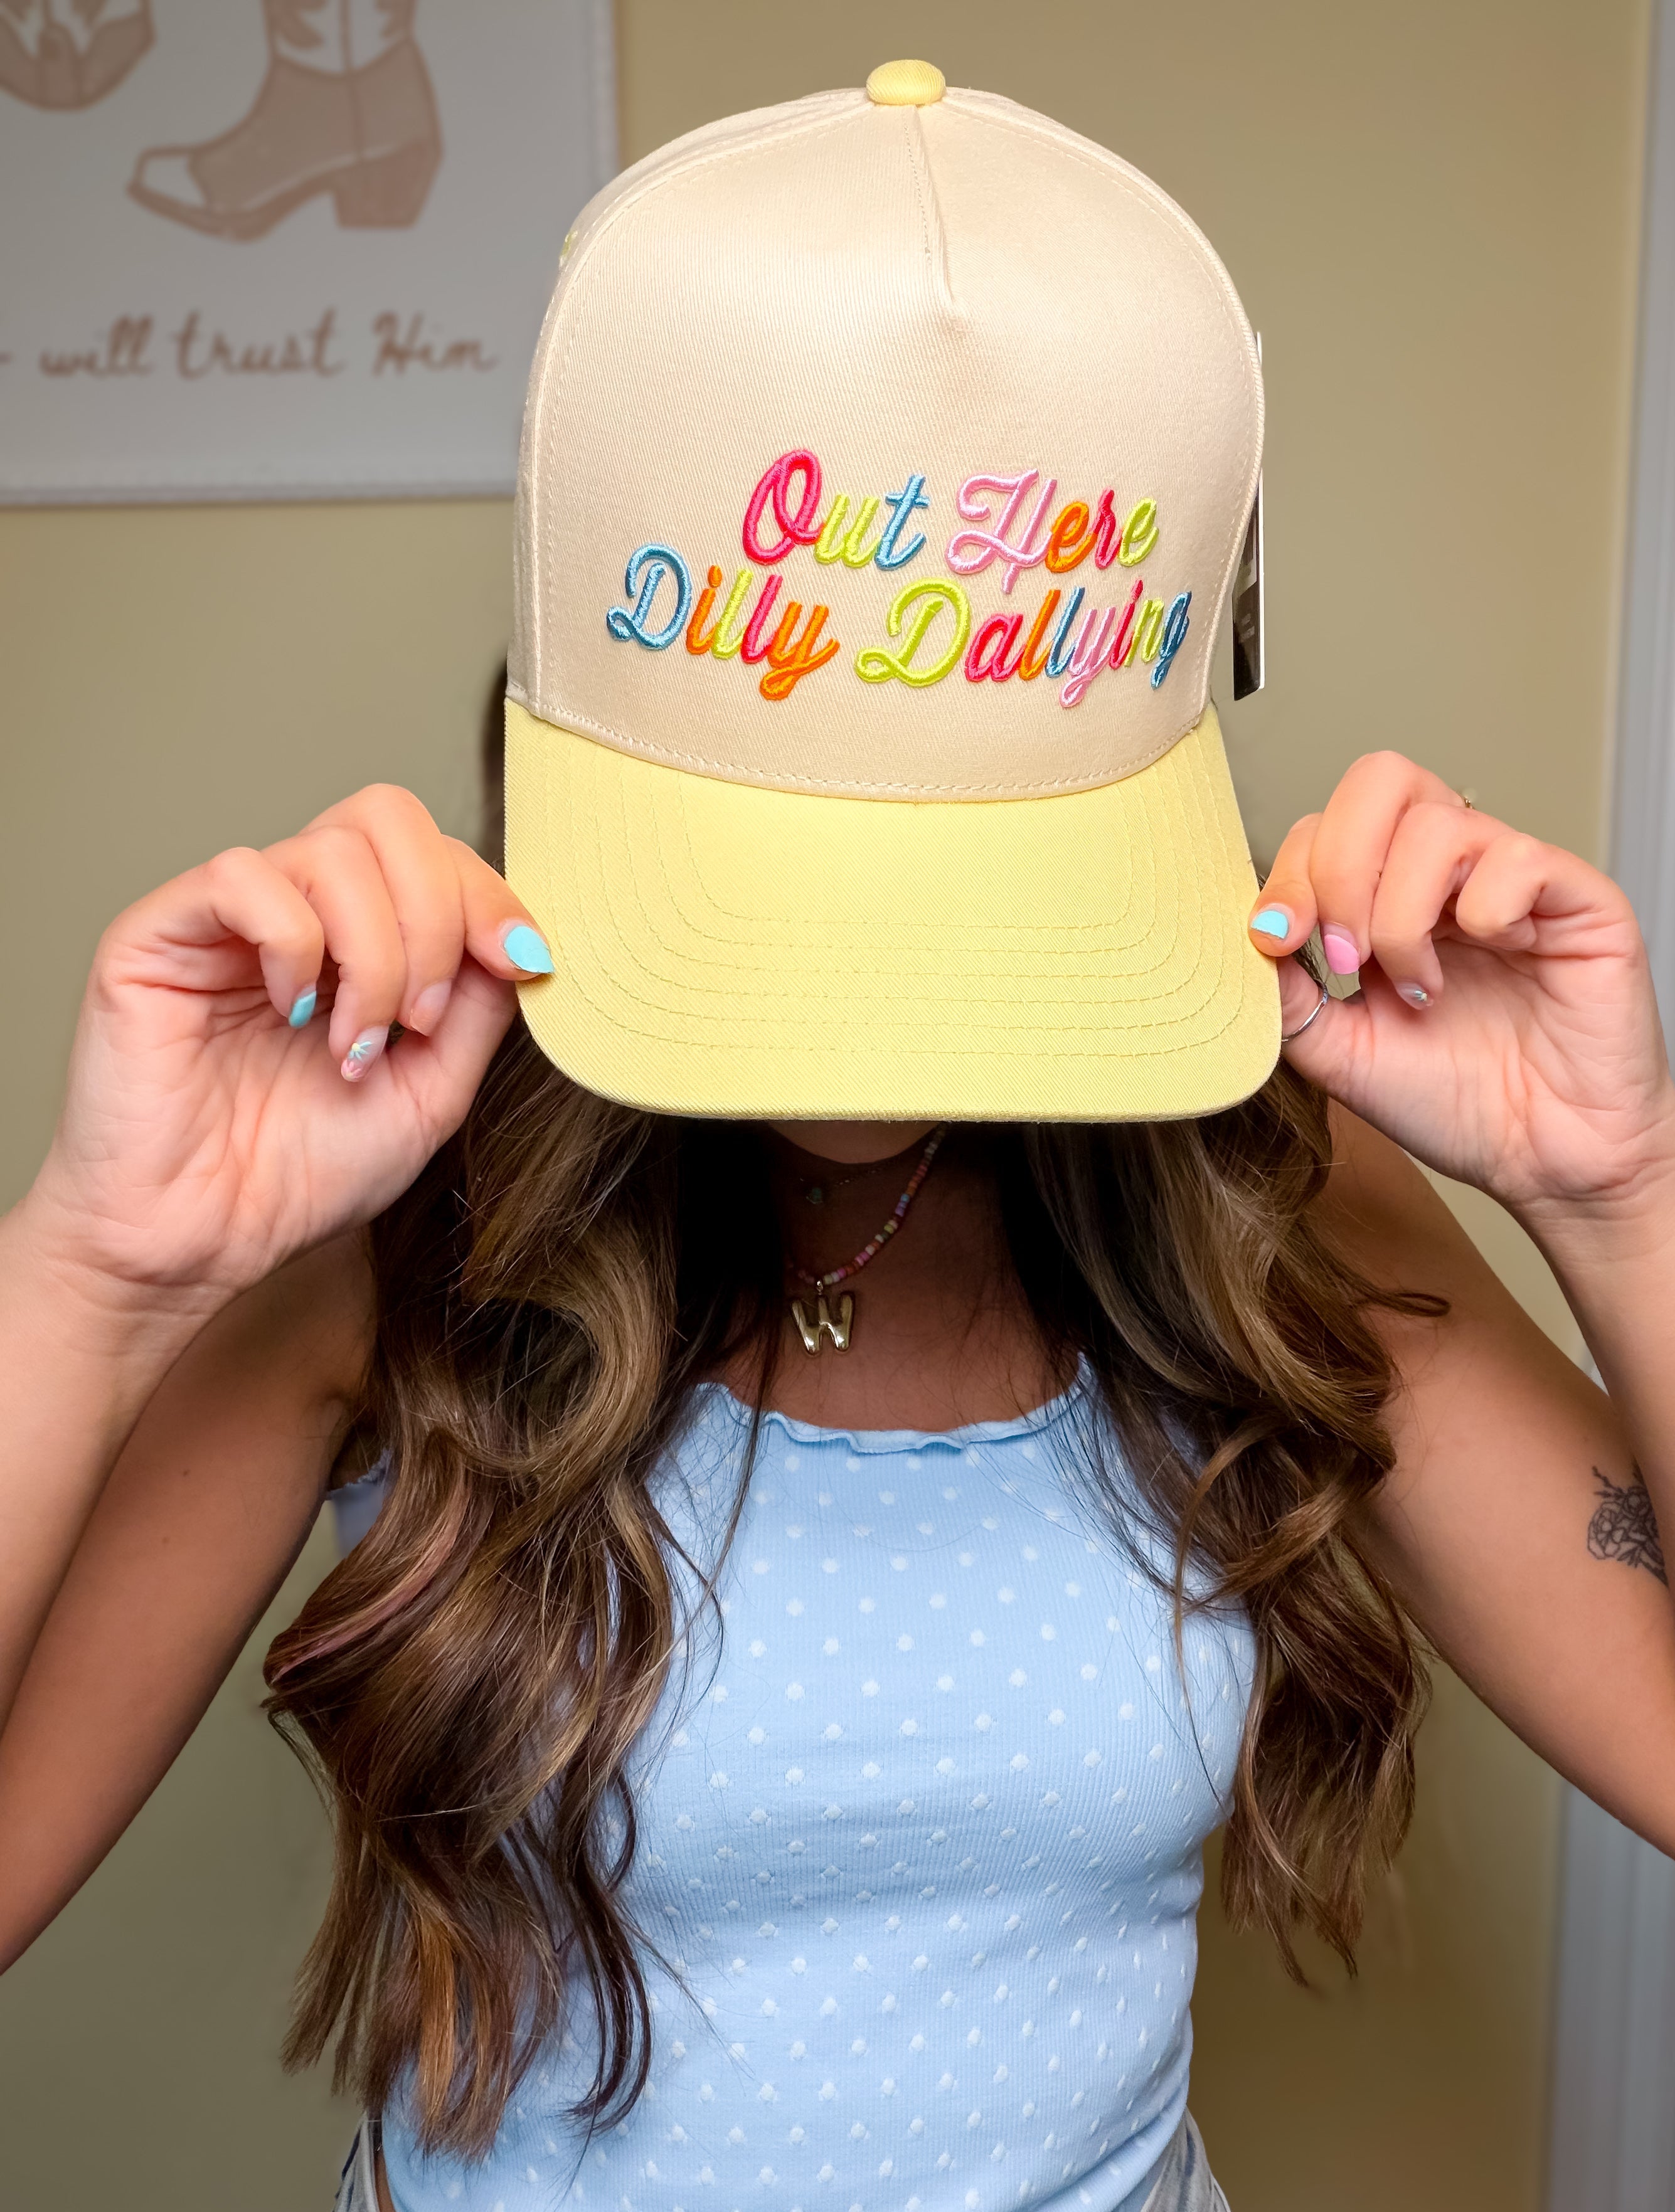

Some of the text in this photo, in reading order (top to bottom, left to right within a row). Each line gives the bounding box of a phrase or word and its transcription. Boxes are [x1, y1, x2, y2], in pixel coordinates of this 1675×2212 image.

[39, 307, 499, 379] will trust Him
[742, 448, 1159, 594] Out Here
[606, 543, 1191, 707] Dilly Dallying
[790, 1292, 854, 1355] W
